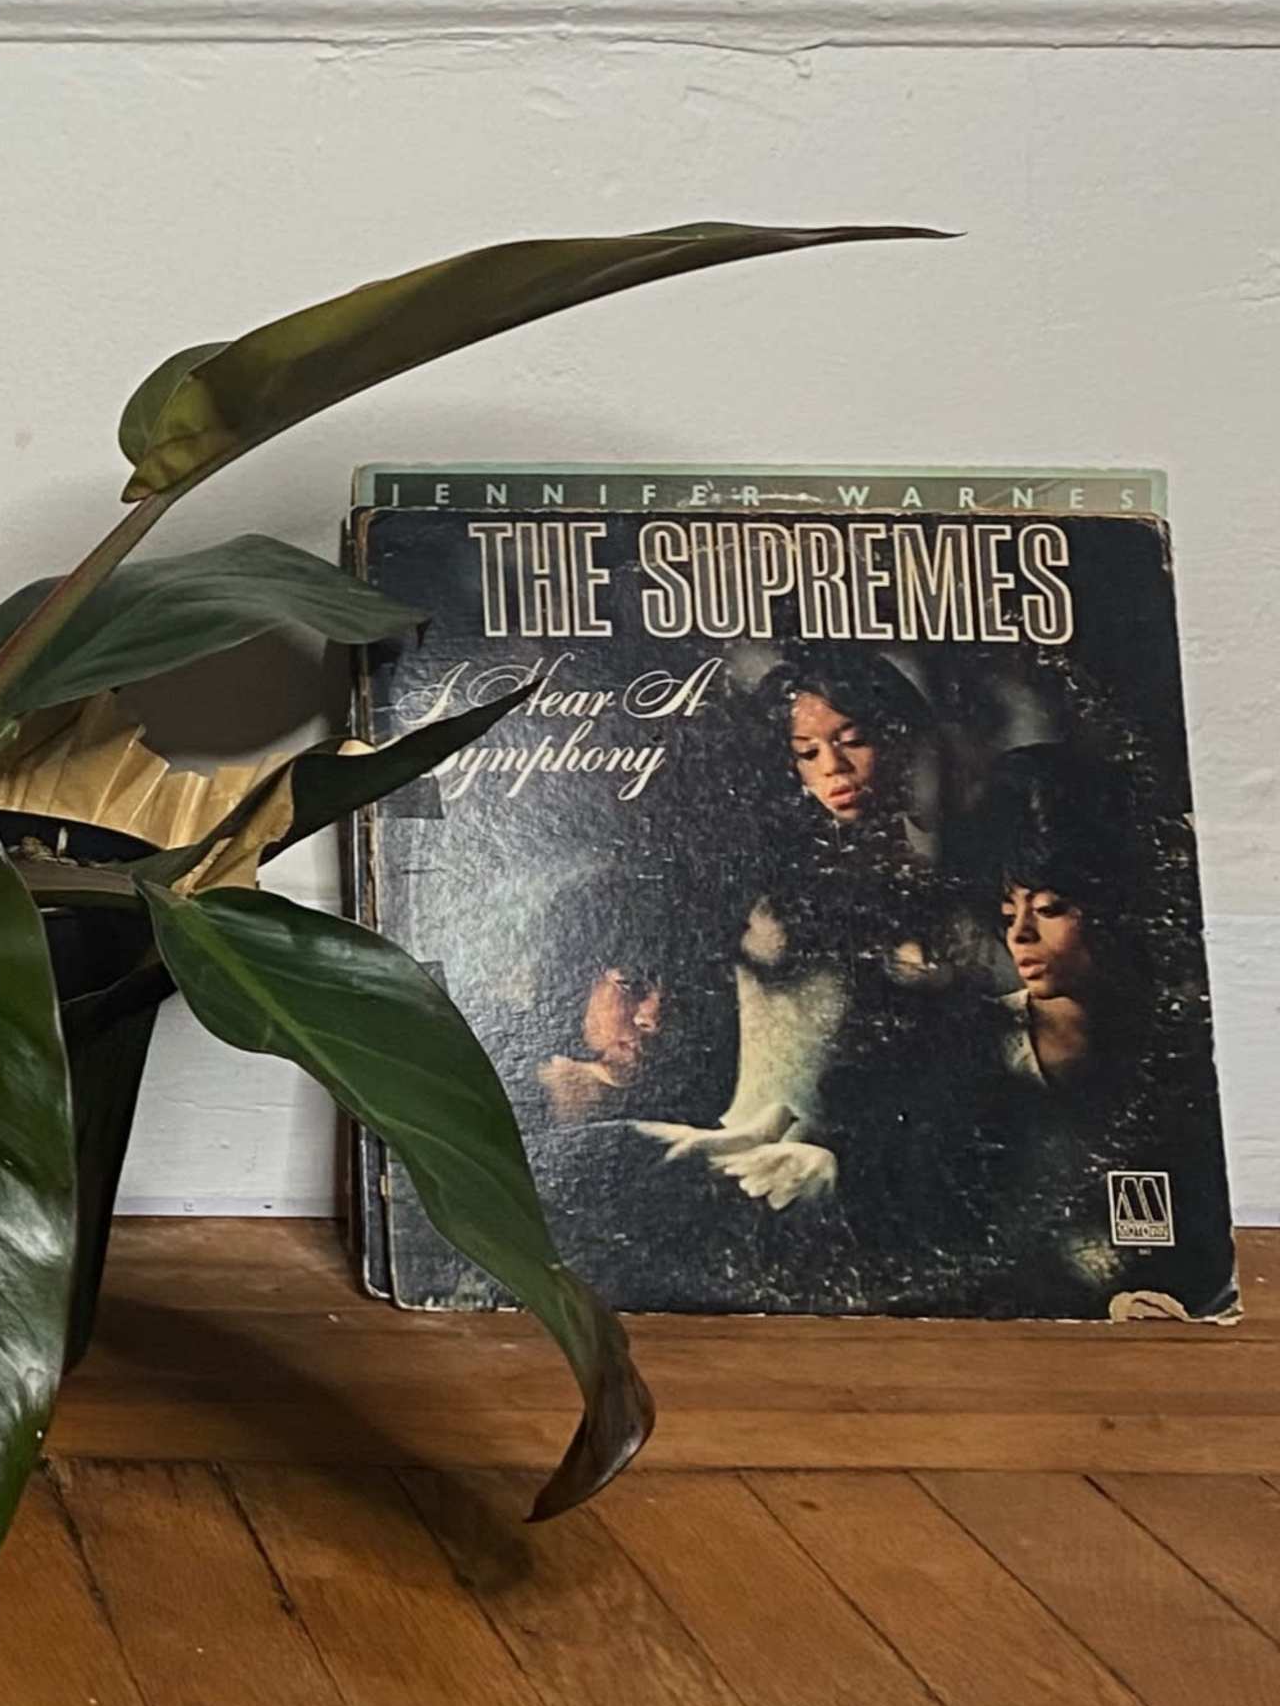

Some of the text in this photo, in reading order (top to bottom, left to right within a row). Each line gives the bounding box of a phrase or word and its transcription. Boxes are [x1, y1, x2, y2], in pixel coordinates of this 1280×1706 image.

[391, 483, 1136, 509] JENNIFER WARNES
[467, 522, 1075, 646] THE SUPREMES
[623, 657, 724, 720] A
